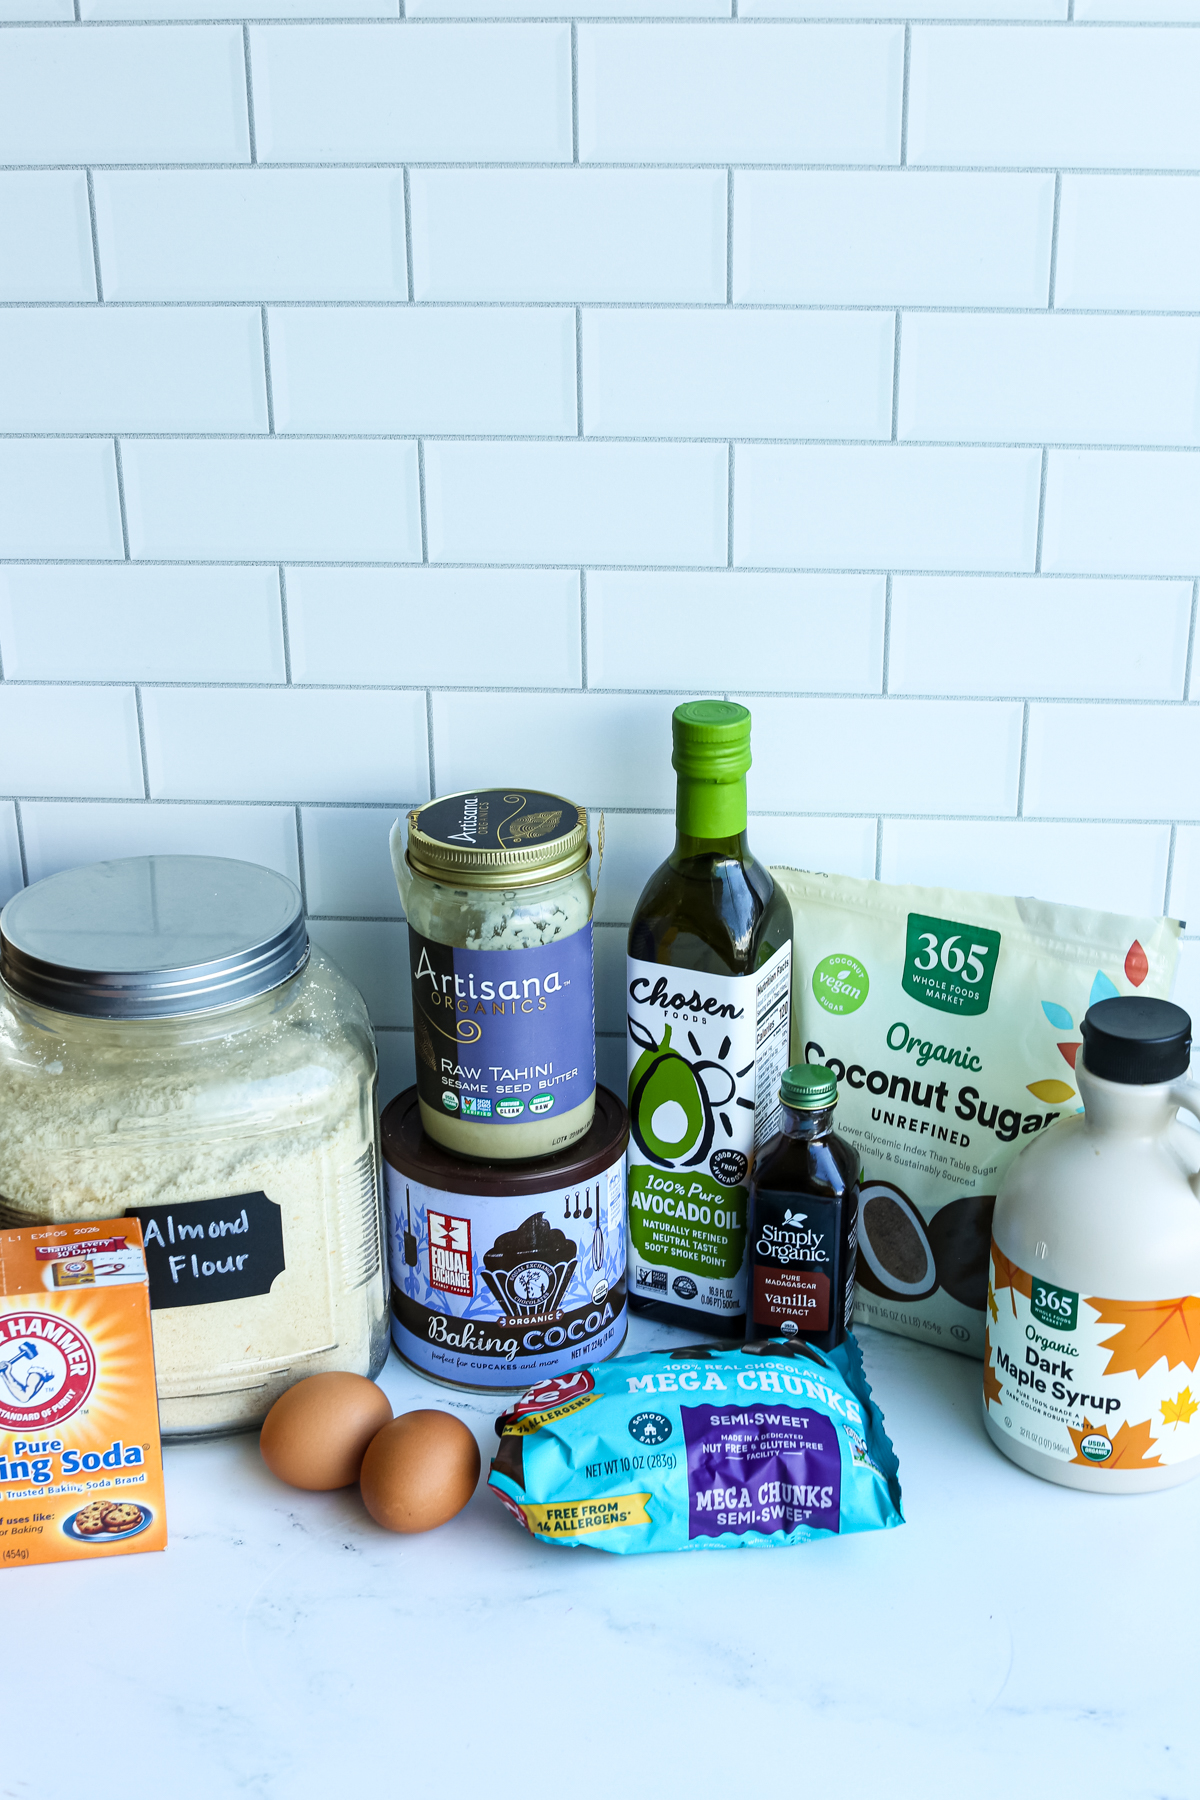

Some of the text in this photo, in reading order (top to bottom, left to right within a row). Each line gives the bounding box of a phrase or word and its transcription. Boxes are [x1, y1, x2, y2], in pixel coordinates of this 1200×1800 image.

[447, 796, 478, 844] Artisana
[829, 957, 864, 978] COCONUT
[914, 932, 989, 983] 365
[414, 946, 563, 1001] Artisana
[820, 972, 861, 1000] vegan
[912, 974, 980, 1000] WHOLE FOODS
[926, 988, 964, 1006] MARKET
[431, 992, 547, 1015] ORGANICS
[629, 976, 744, 1020] Chosen
[820, 996, 844, 1012] SUGAR
[664, 1010, 708, 1025] FOODS
[886, 1021, 982, 1072] Organic
[441, 1068, 578, 1094] SESAME SEED BUTTER
[954, 1086, 1060, 1142] Sugar
[871, 1107, 970, 1148] UNREFINED
[714, 1152, 746, 1166] GOOD FATS
[838, 1122, 998, 1176] Lower Glycemic Index Than Table Sugar
[712, 1166, 743, 1184] AVOCADOS
[720, 1162, 738, 1172] FROM
[852, 1140, 976, 1188] Ethically & Sustainably Sourced
[644, 1174, 724, 1204] 100% Pure
[631, 1190, 711, 1225] AVOCADO
[714, 1209, 741, 1230] OIL
[73, 1226, 100, 1236] 2026
[144, 1208, 249, 1248] Almond
[642, 1218, 728, 1245] NATURALLY REFINED
[762, 1224, 825, 1250] Simply
[37, 1240, 110, 1254] Change Every
[57, 1247, 98, 1259] 30 Days
[652, 1232, 718, 1254] NEUTRAL TASTE
[168, 1254, 249, 1284] Flour
[431, 1246, 470, 1274] EQUAL
[670, 1247, 698, 1261] SMOKE
[700, 1254, 726, 1268] POINT
[432, 1266, 470, 1289] EXCHANGE
[510, 1263, 553, 1282] EQUAL EXCHANGE
[764, 1278, 817, 1290] MADAGASCAR
[780, 1274, 801, 1282] PURE
[514, 1292, 550, 1305] CHOCOLATES
[708, 1286, 719, 1297] 16.9
[764, 1293, 817, 1308] vanilla
[1034, 1287, 1073, 1317] 365
[508, 1313, 554, 1326] ORGANIC
[770, 1306, 810, 1316] EXTRACT
[853, 1301, 942, 1335] NET WT 16 OZ 454g
[1034, 1306, 1071, 1324] WHOLE FOODS
[1041, 1314, 1062, 1327] MARKET
[428, 1302, 614, 1362] Baking COCOA
[1025, 1324, 1080, 1357] Organic
[7, 1318, 88, 1377] HAMMER
[571, 1338, 603, 1360] NET 224g
[430, 1351, 559, 1371] perfect for CUPCAKES and more
[1025, 1346, 1074, 1382] Dark
[662, 1362, 827, 1385] 100% REAL CHOCOLATE
[996, 1345, 1122, 1415] Maple Syrup
[0, 1388, 76, 1422] TANDARD OF PURITY
[626, 1371, 727, 1394] MEGA
[736, 1370, 863, 1424] CHUNKS
[1006, 1389, 1020, 1402] DARK
[1020, 1400, 1041, 1414] COLOR
[1042, 1411, 1069, 1424] ROBUST
[1016, 1388, 1030, 1401] PURE
[1049, 1405, 1072, 1417] GRADE
[632, 1413, 666, 1426] SCHOOL
[14, 1440, 62, 1456] Pure
[638, 1436, 664, 1444] SAFE
[702, 1440, 824, 1454] NUT FREE GLUTEN FREE
[720, 1432, 804, 1442] MADE IN DEDICATED
[1088, 1440, 1106, 1448] USDA
[0, 1442, 142, 1484] ing Soda
[586, 1453, 678, 1479] NET WT 10 OZ (283g)
[746, 1450, 780, 1462] FACILITY
[6, 1488, 44, 1498] Trusted
[48, 1482, 83, 1494] Baking
[86, 1480, 111, 1490] Soda
[115, 1474, 145, 1486] Brand
[696, 1480, 834, 1512] MEGA CHUNKS
[6, 1512, 55, 1525] uses like:
[546, 1502, 618, 1520] FREE FROM
[11, 1524, 44, 1535] Baking
[536, 1520, 552, 1532] 14
[2, 1548, 30, 1562] (454g)
